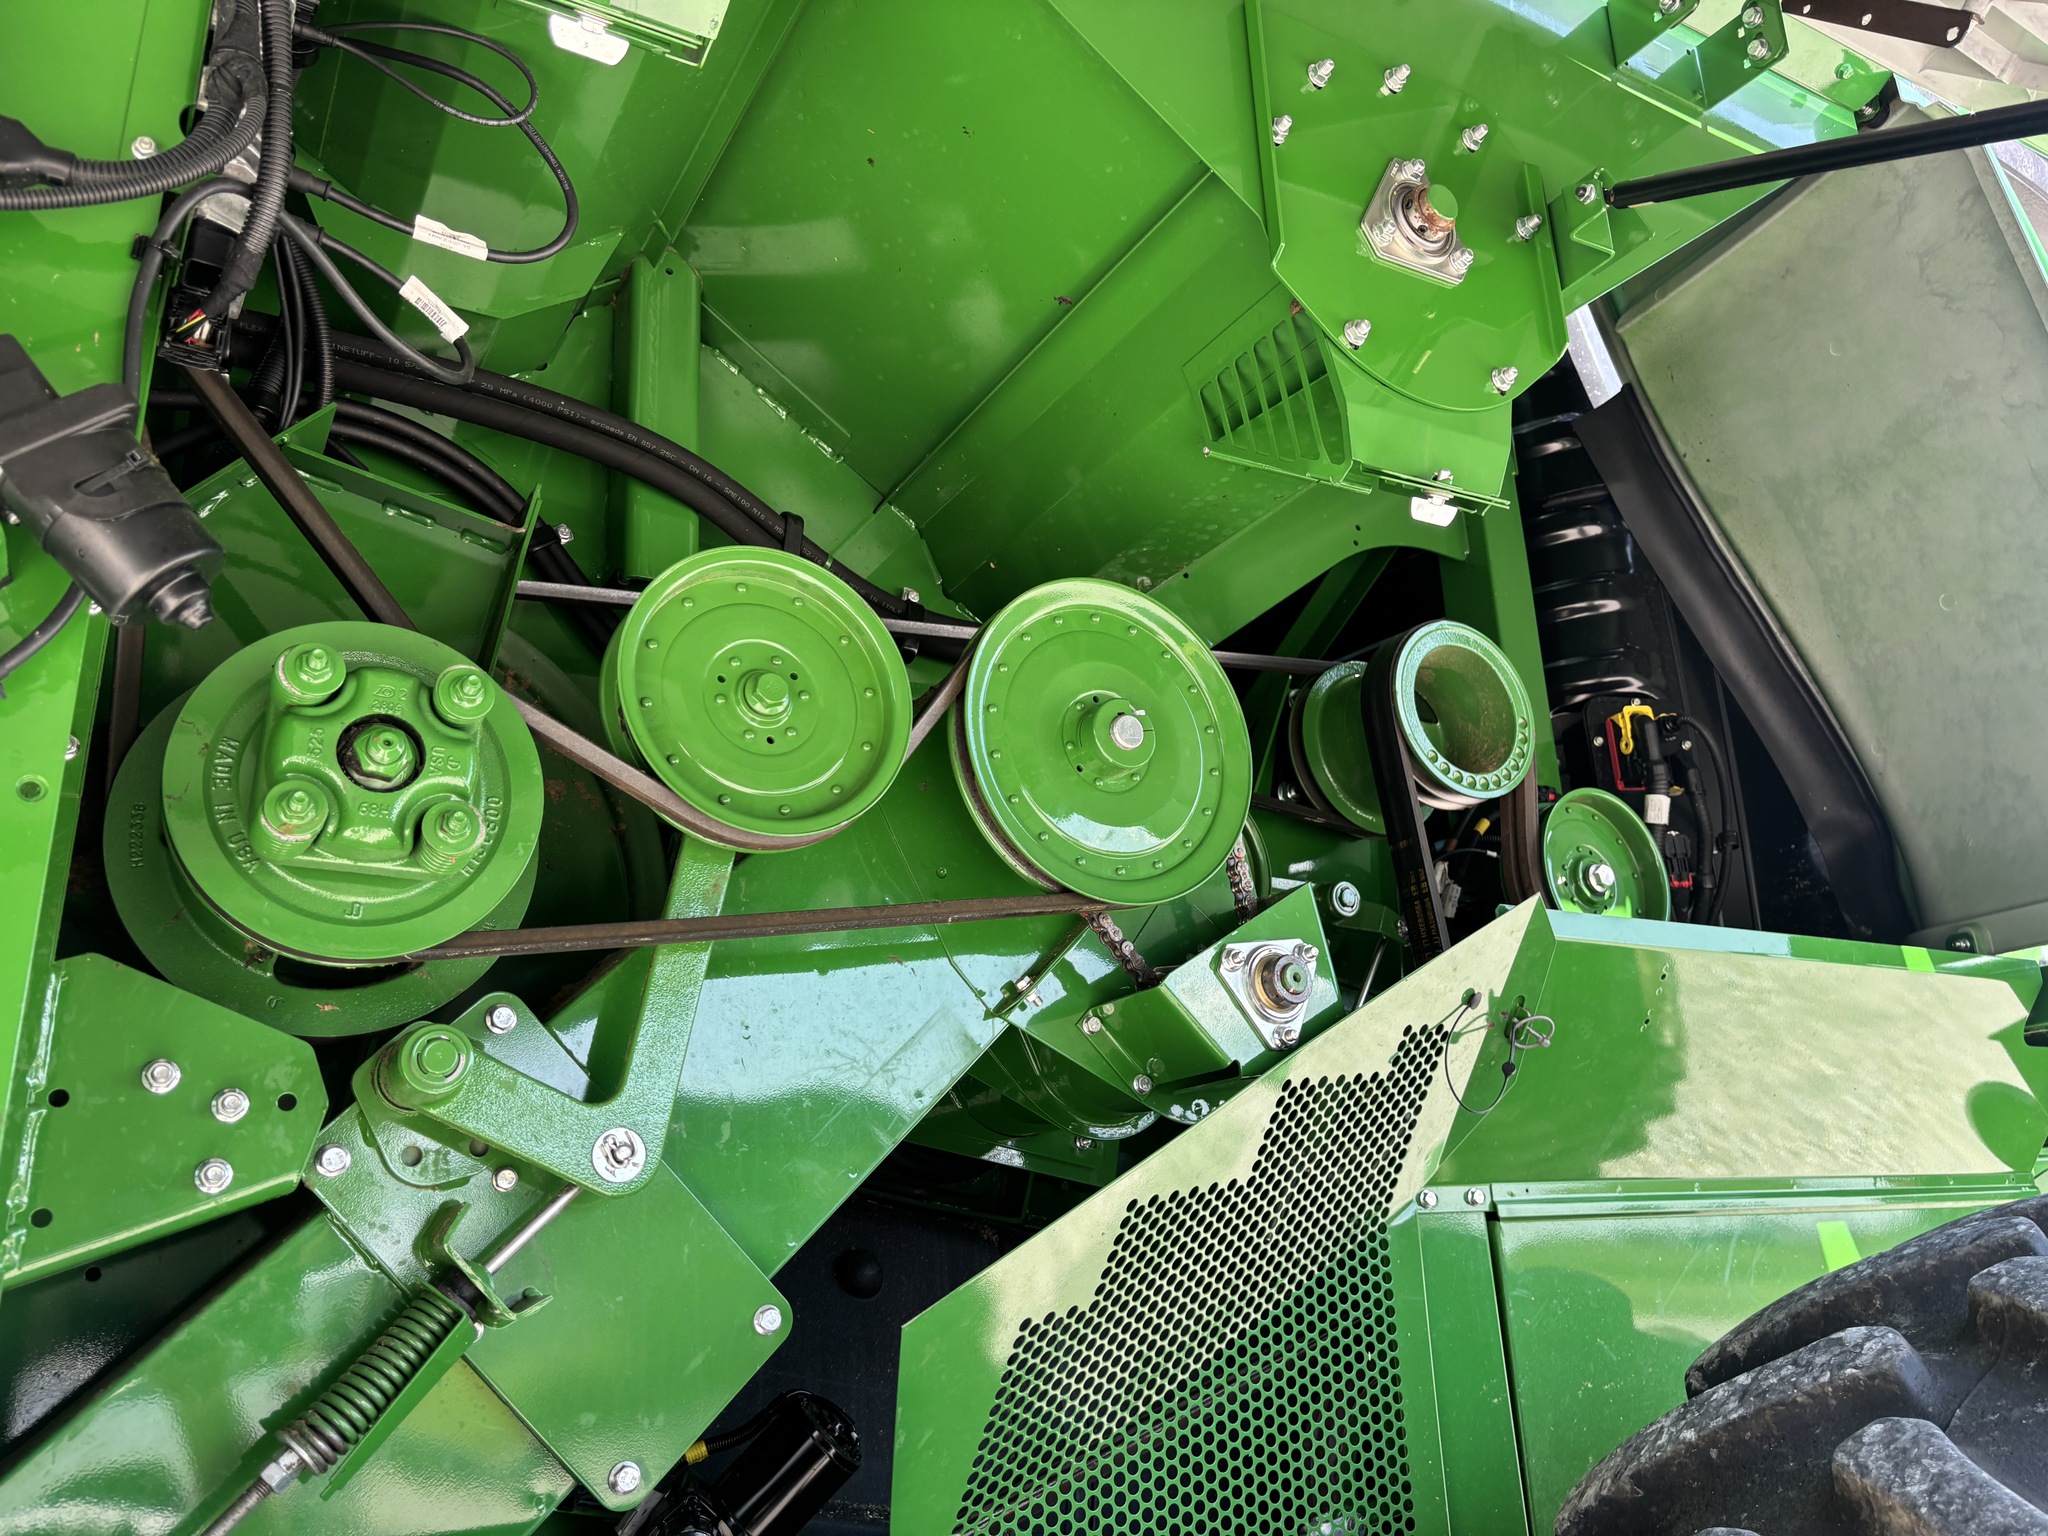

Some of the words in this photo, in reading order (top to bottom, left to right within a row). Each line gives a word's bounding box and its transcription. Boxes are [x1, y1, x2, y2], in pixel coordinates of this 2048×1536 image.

[523, 396, 553, 409] (4000
[590, 419, 624, 436] exceeds
[627, 433, 639, 443] EN
[689, 464, 700, 475] DN
[211, 735, 241, 791] MADE
[428, 745, 446, 777] USA
[214, 802, 237, 824] IN
[227, 831, 262, 875] USA
